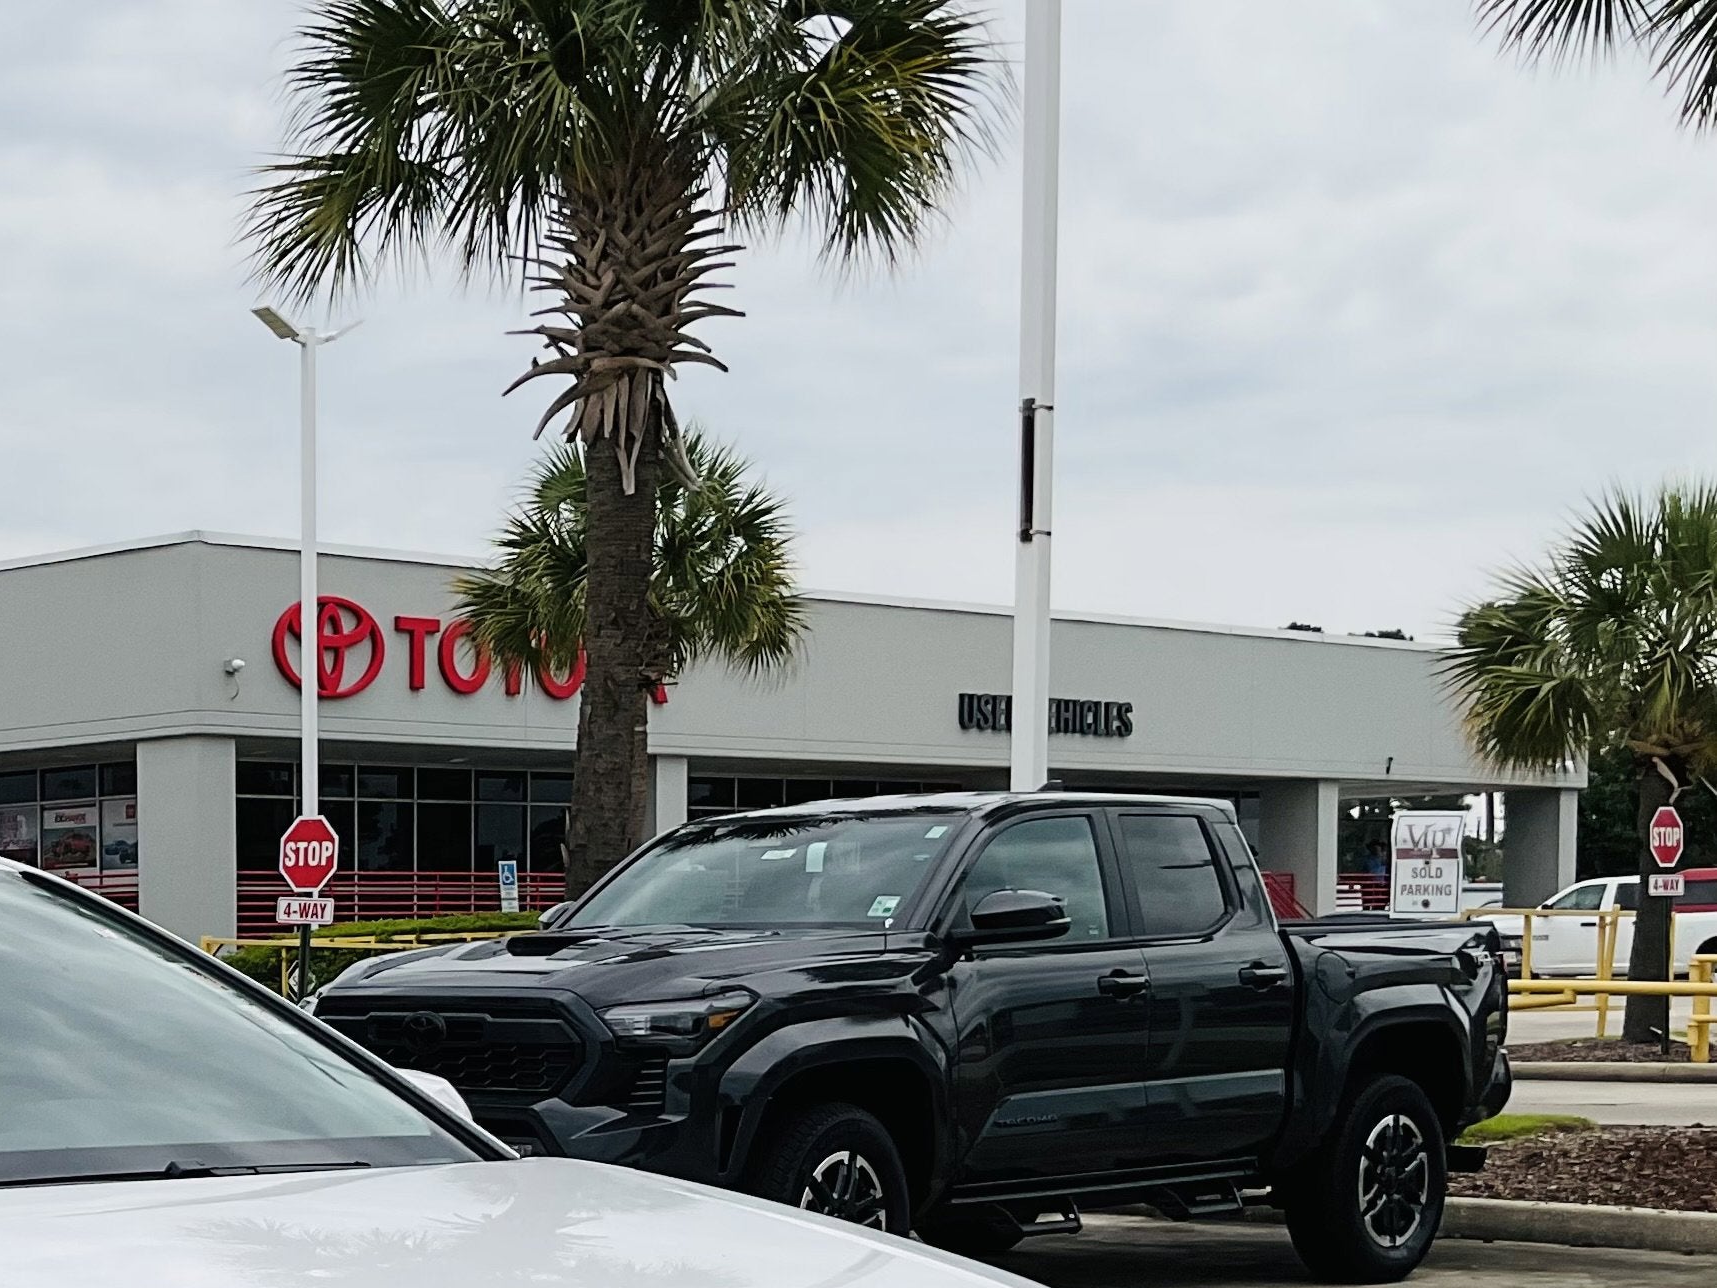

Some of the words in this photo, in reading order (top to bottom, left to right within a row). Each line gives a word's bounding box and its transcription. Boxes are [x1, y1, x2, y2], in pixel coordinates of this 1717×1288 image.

[394, 615, 668, 704] TOO
[958, 693, 1013, 731] USE
[1048, 698, 1133, 737] EHICLES
[1653, 827, 1680, 847] STOP
[284, 841, 333, 867] STOP
[1411, 867, 1443, 879] SOLD
[1400, 884, 1452, 896] PARKING
[1653, 878, 1680, 891] 4-WAY
[283, 902, 327, 920] 4-WAY
